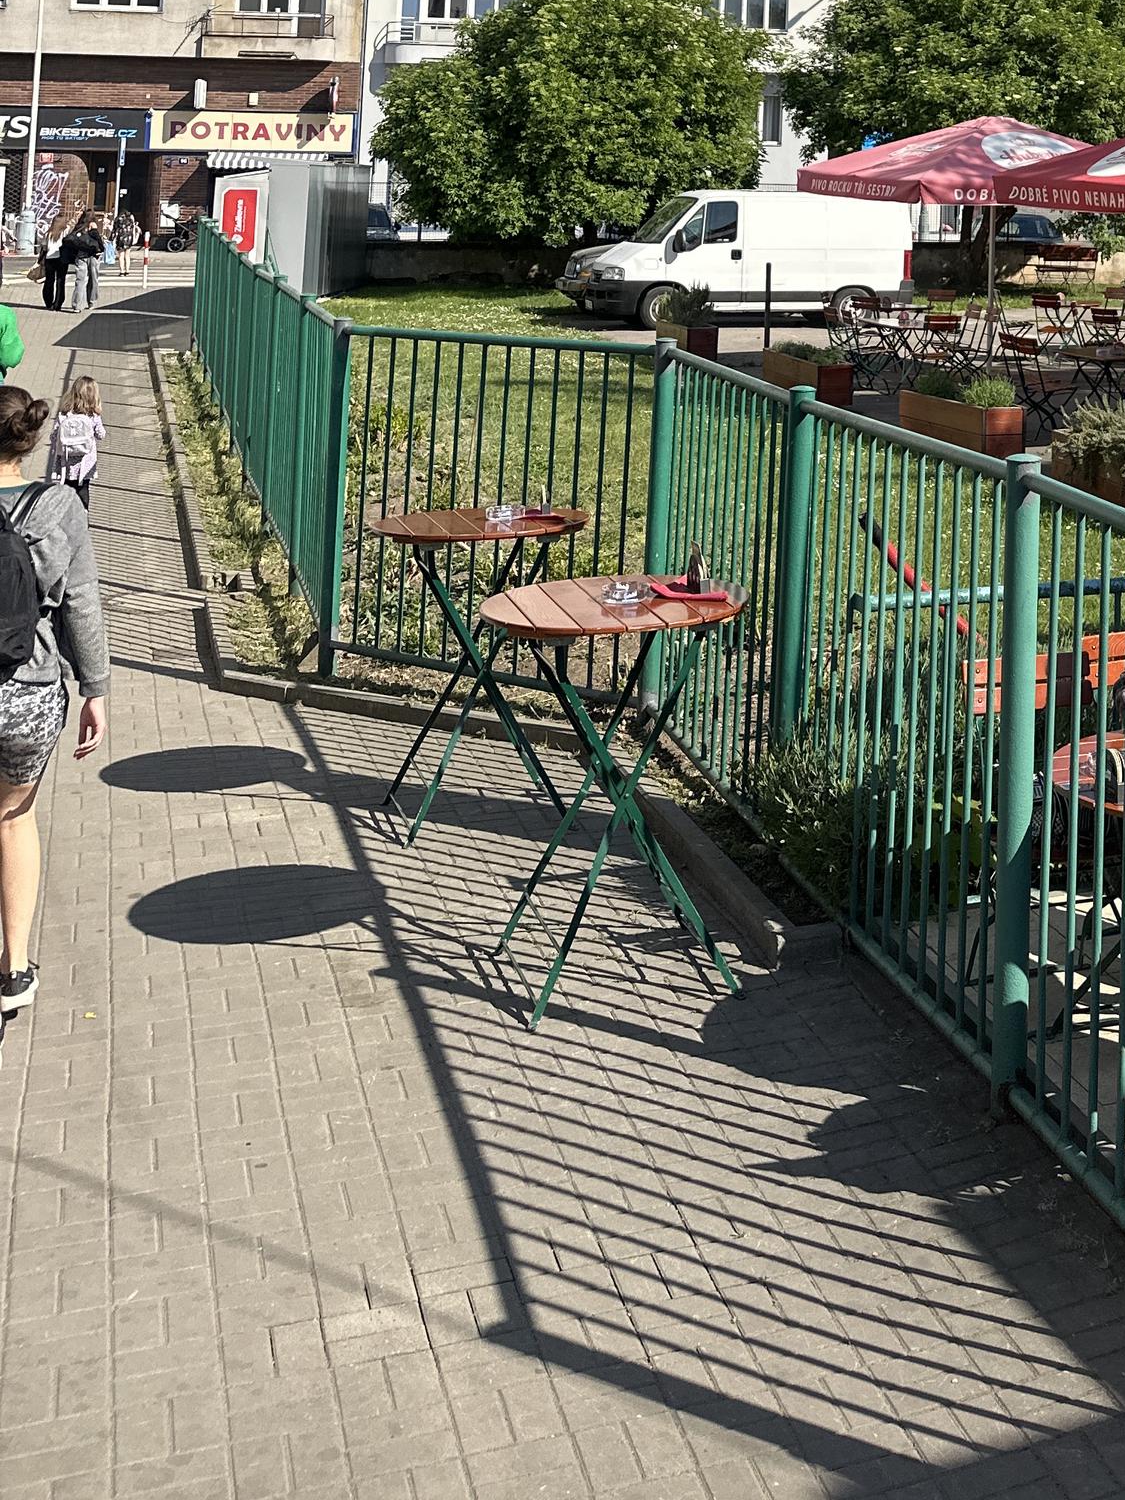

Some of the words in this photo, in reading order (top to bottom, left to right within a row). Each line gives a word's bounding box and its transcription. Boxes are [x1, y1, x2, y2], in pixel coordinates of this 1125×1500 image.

[39, 127, 138, 138] BIKESTORE.CZ
[169, 120, 346, 142] POTRAVINY
[810, 179, 827, 191] PIVO
[828, 180, 853, 193] ROCKU
[854, 179, 866, 194] TŘI
[867, 183, 897, 197] SESTRY
[954, 188, 997, 201] DOB
[1008, 185, 1049, 203] DOBRÉ
[1052, 188, 1080, 205] PIVO
